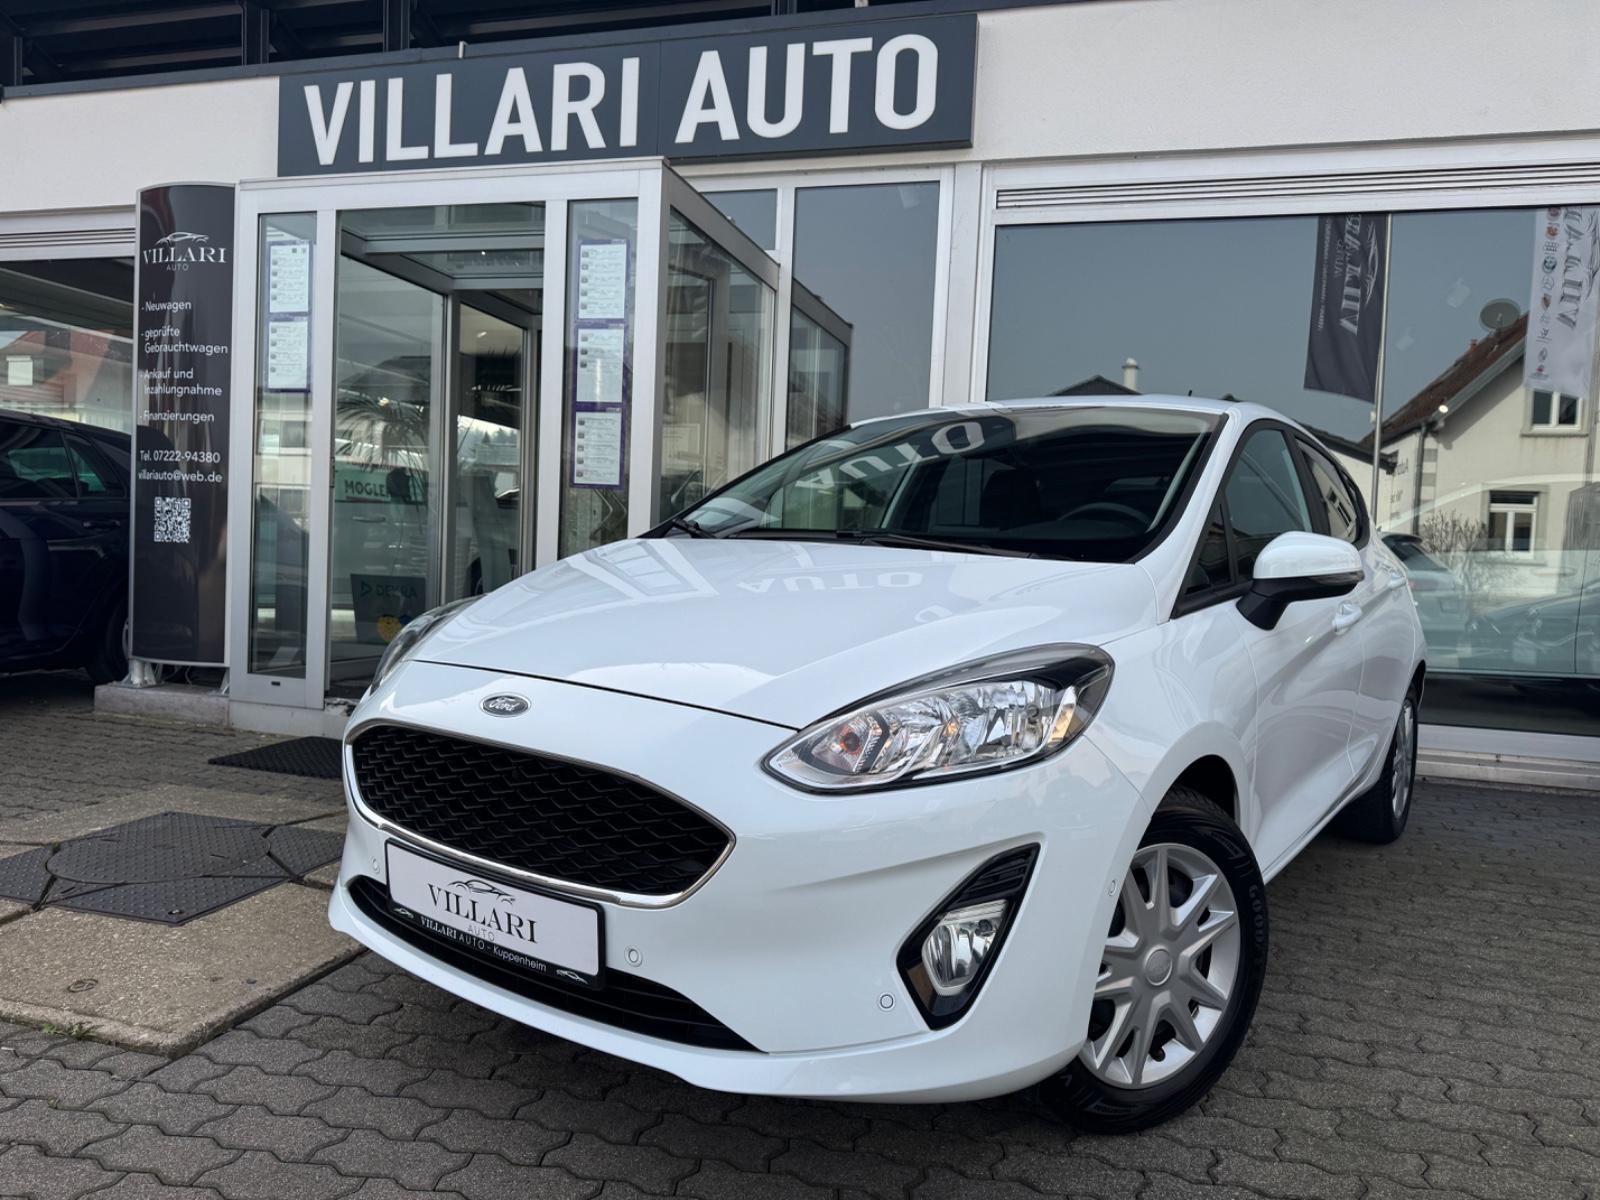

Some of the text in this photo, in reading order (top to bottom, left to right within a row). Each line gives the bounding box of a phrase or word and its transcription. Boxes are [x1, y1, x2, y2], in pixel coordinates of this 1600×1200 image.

[304, 34, 939, 166] VILLARI AUTO
[143, 247, 227, 265] VILLARI
[166, 263, 189, 272] AUTO
[145, 301, 192, 313] Neuwagen
[144, 340, 228, 356] Gebrauchtwagen
[173, 368, 194, 379] und
[144, 382, 222, 397] Inzahlungnahme
[144, 409, 215, 424] Finanzierungen
[140, 450, 221, 463] Tel. 07222-94380
[138, 469, 223, 483] villariauto@web.de
[344, 479, 390, 498] MOGLE
[427, 882, 538, 945] VILLARI
[467, 924, 496, 942] AUTO
[420, 915, 457, 940] VILLARI
[458, 932, 485, 950] AUTO
[493, 945, 547, 973] Kuppenheim
